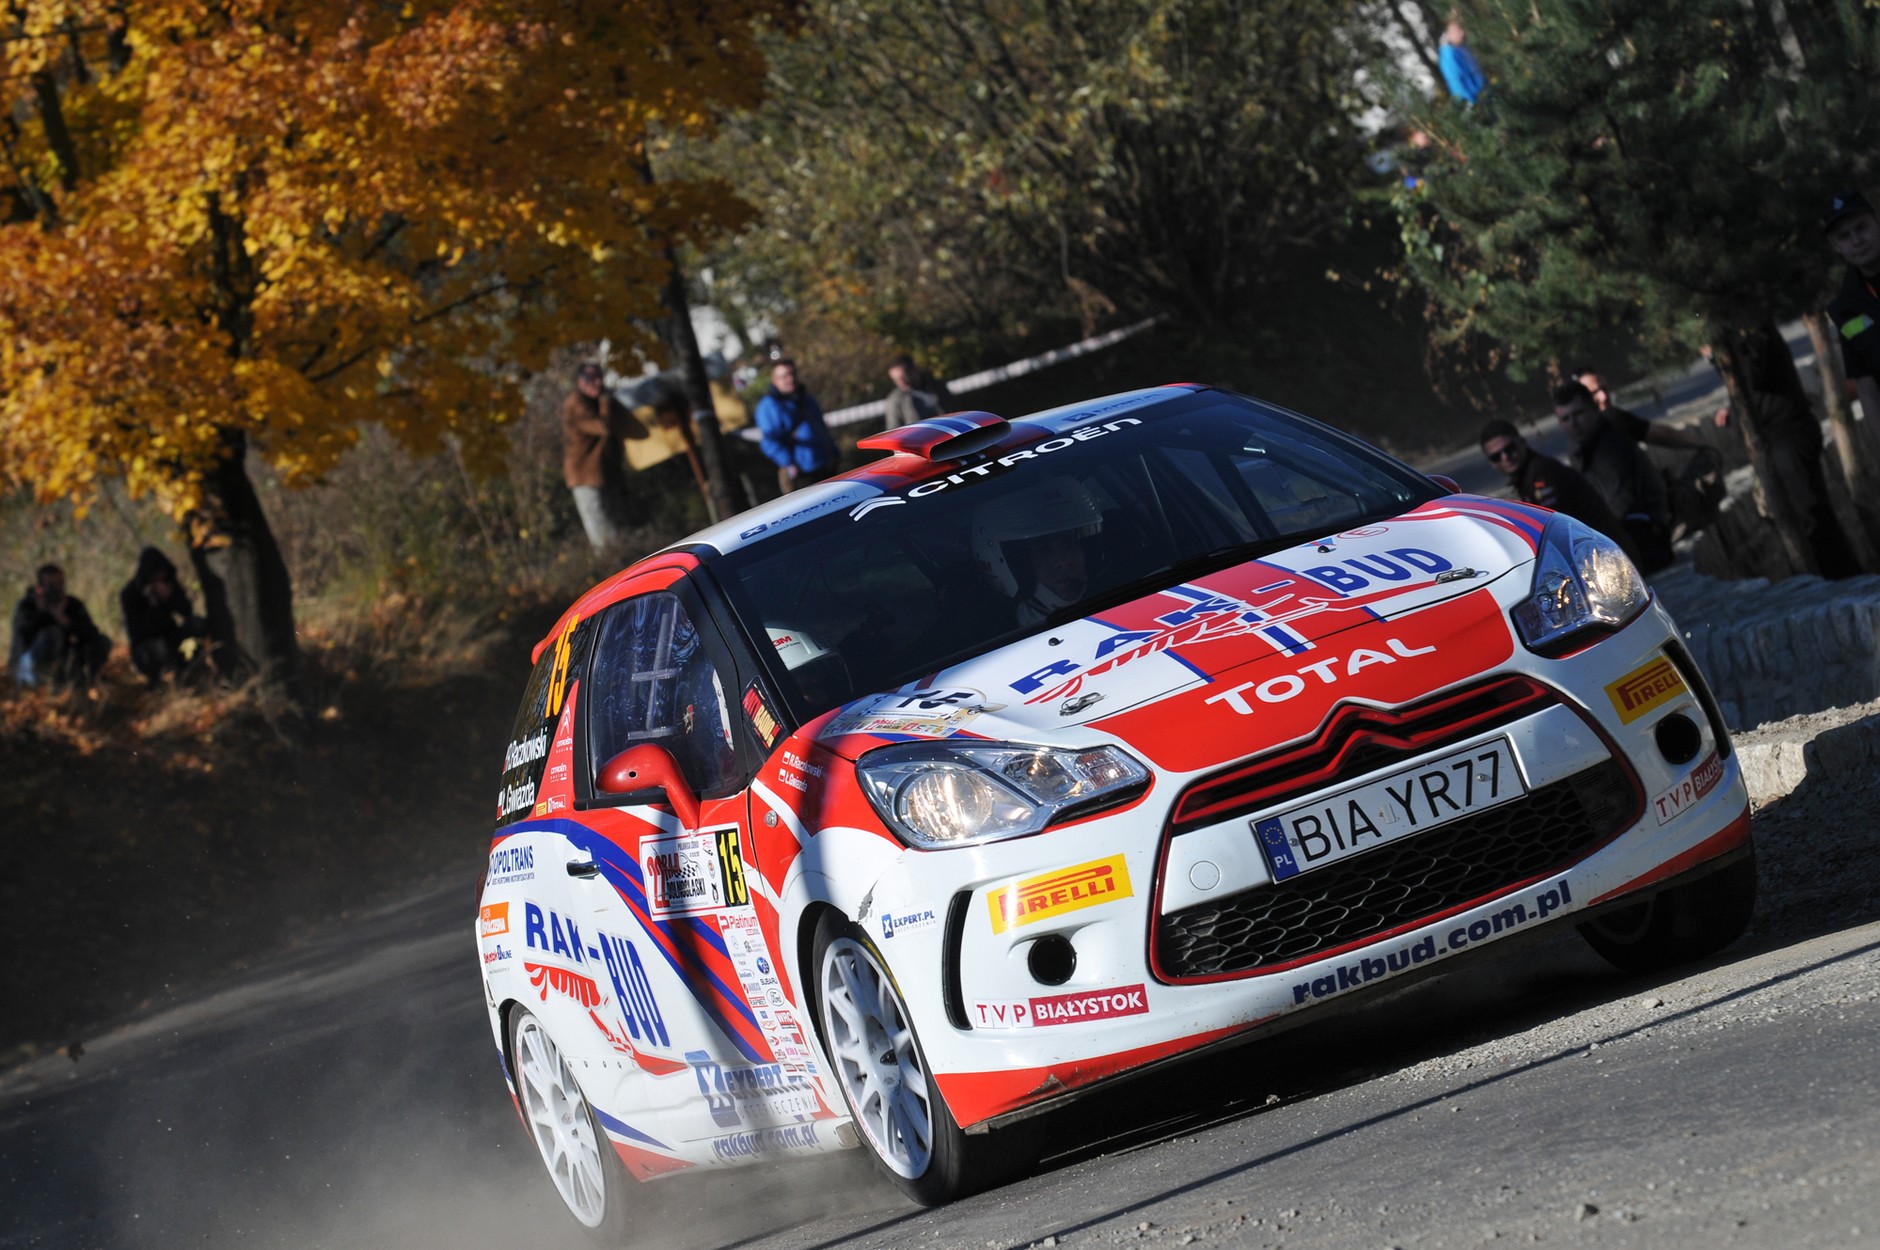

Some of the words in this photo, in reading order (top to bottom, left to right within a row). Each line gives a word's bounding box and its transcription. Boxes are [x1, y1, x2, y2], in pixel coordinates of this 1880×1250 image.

[545, 612, 580, 718] 15
[1205, 638, 1437, 715] TOTAL
[1616, 661, 1681, 712] PIRELL
[896, 690, 975, 709] 15
[1292, 799, 1382, 862] BIA
[1385, 750, 1499, 826] YR77
[1656, 782, 1693, 817] TVP
[647, 856, 670, 908] 22
[719, 833, 747, 904] 15
[1274, 855, 1293, 869] PL
[998, 864, 1115, 921] PIRELLI
[729, 915, 759, 930] Platinum
[894, 910, 935, 928] EXPERT.PL
[1292, 879, 1572, 1005] rakbud.com.pl
[525, 902, 670, 1047] RAK-BUD
[760, 978, 778, 986] SUBARU
[776, 1012, 793, 1023] WRC
[977, 1004, 1027, 1023] TVP
[1035, 992, 1144, 1020] BIAŁYSTOK
